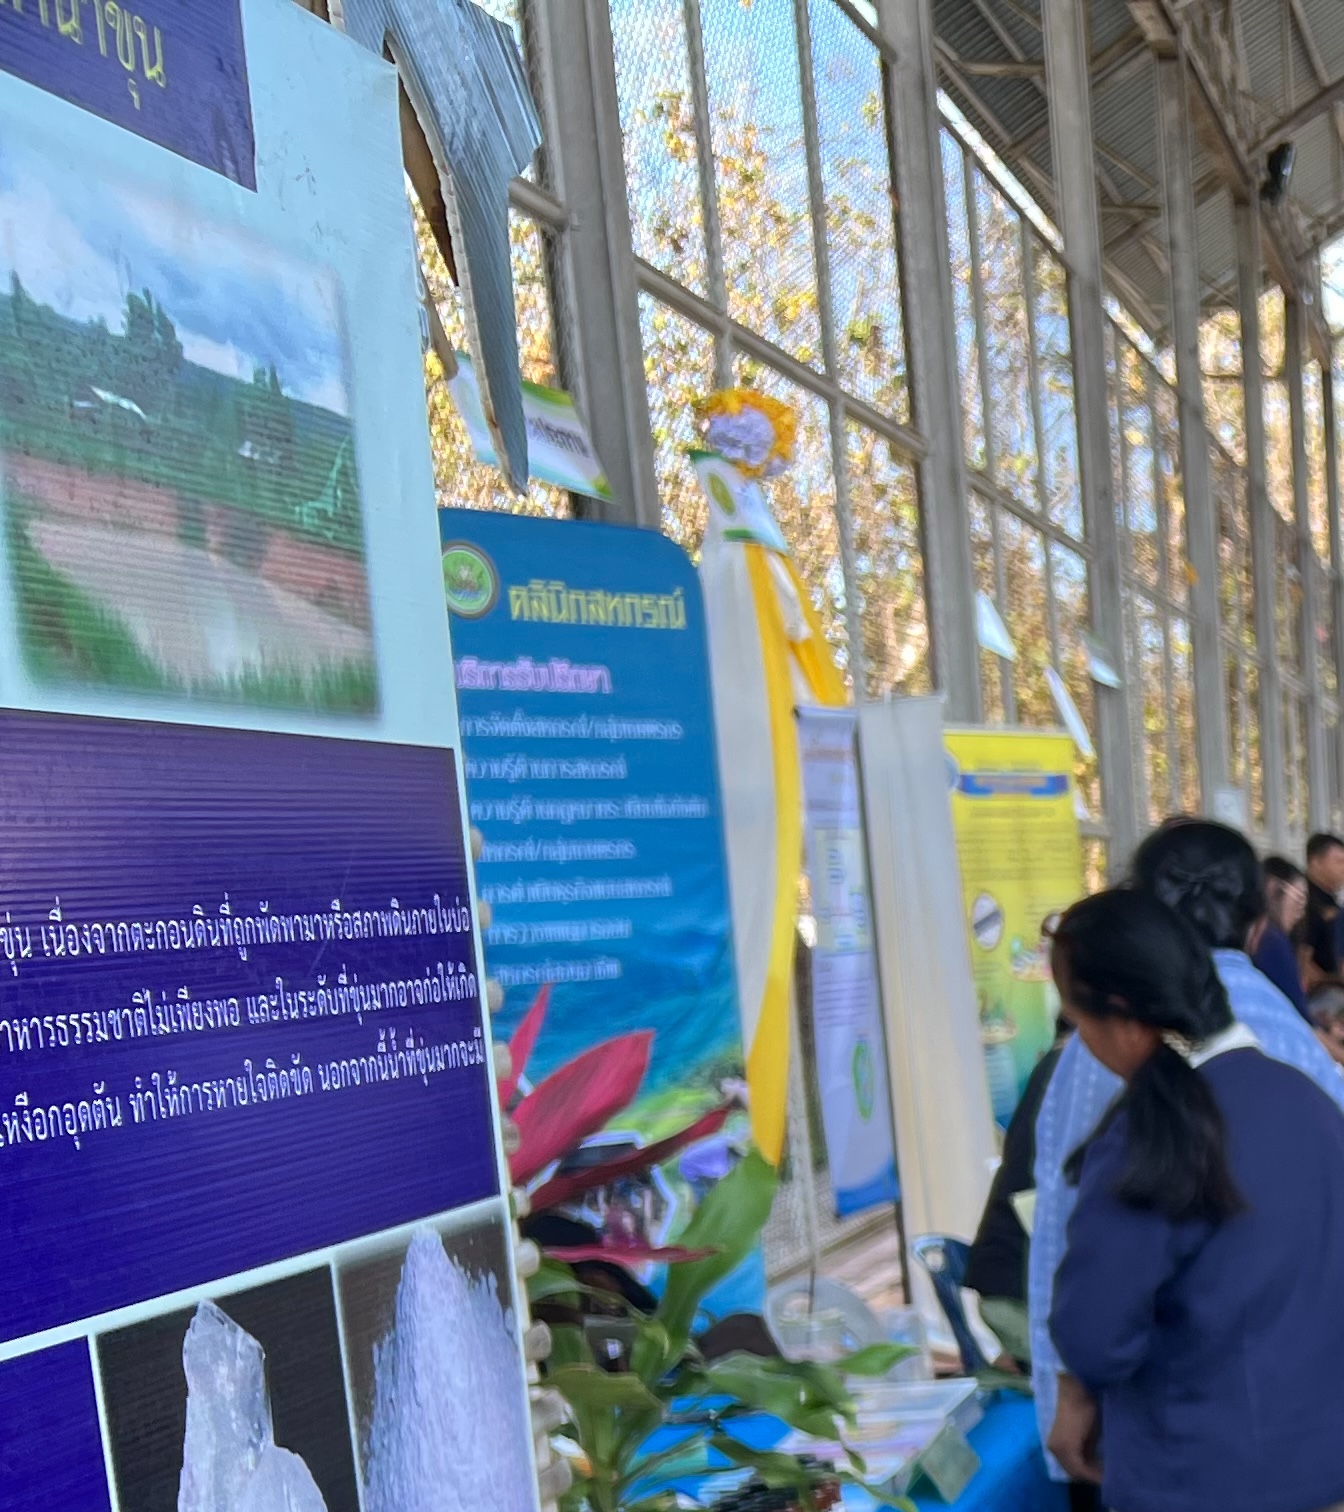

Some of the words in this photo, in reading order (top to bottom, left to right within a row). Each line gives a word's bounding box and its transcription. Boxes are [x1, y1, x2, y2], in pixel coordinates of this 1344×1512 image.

[246, 961, 477, 1026] และในระดับที่ขุ่นมากอาจก่อให้เกิด
[129, 1052, 314, 1123] ทำให้การหายใจติดขัด
